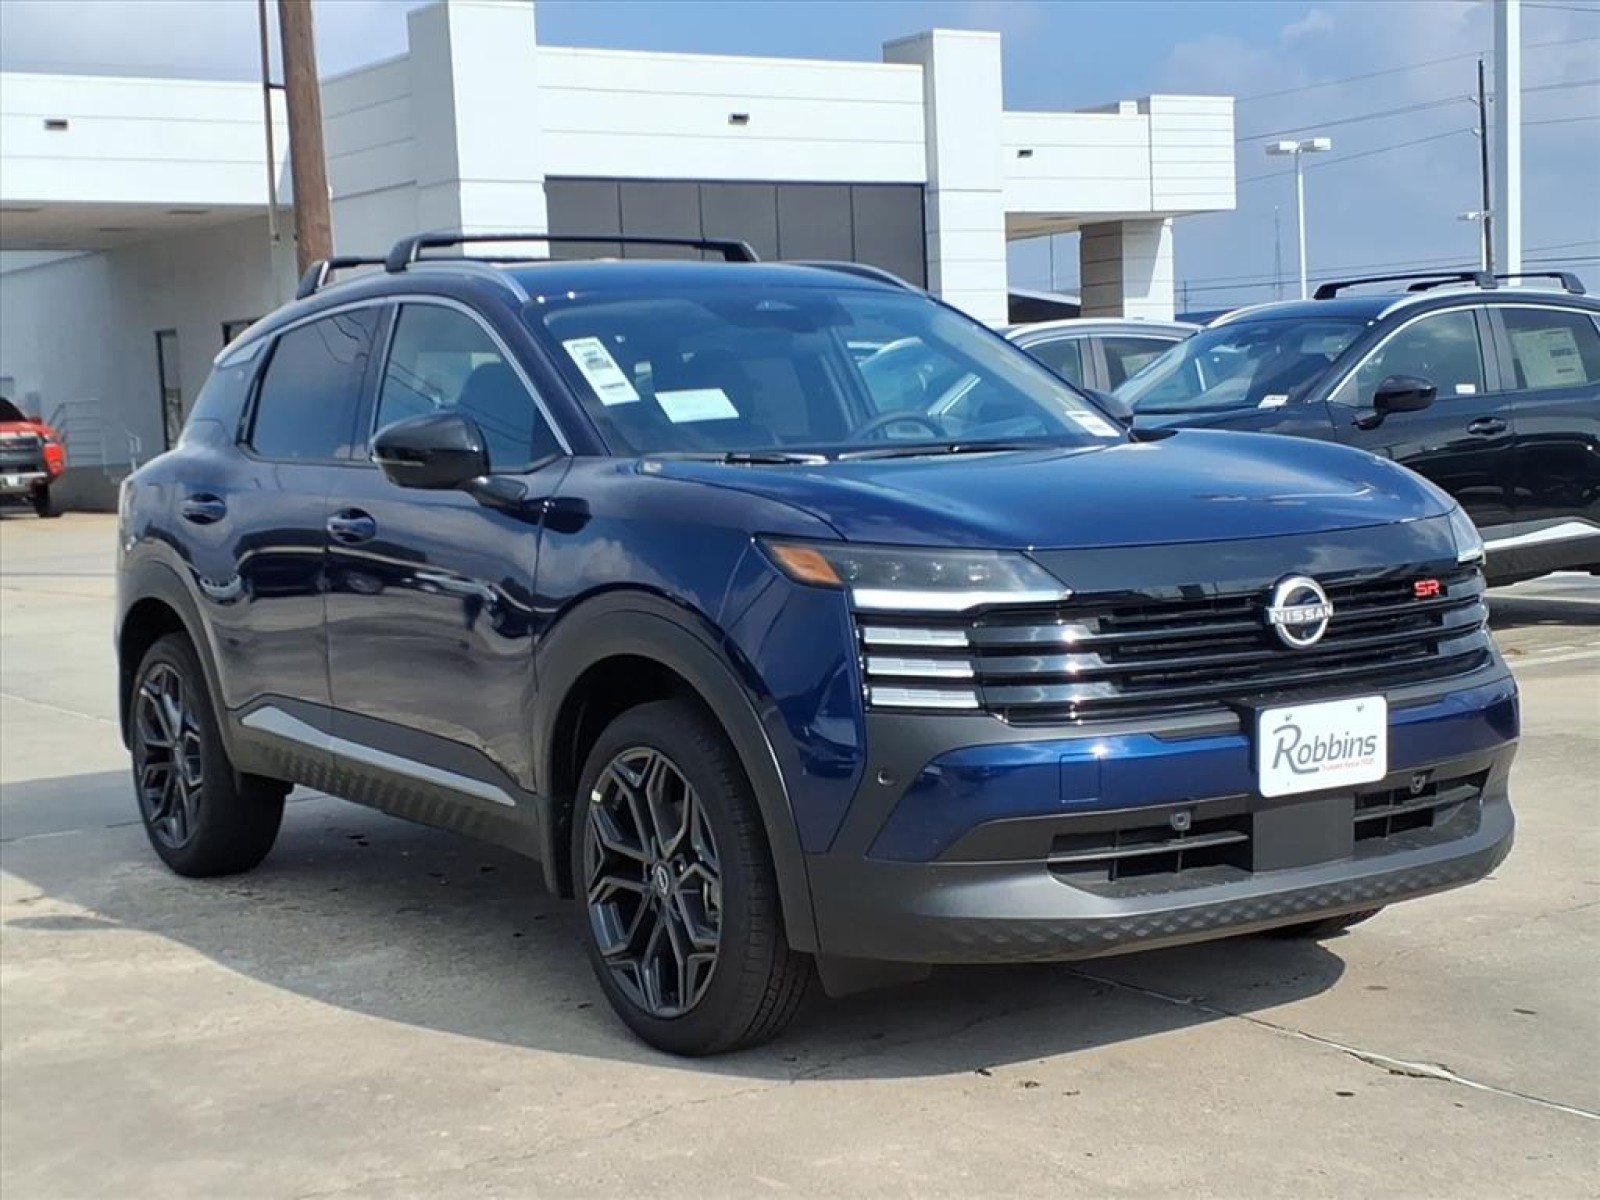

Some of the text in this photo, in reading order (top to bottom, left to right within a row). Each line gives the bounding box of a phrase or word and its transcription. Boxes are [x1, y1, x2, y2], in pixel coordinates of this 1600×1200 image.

[1414, 579, 1440, 597] SR
[1269, 602, 1333, 624] NISSAN
[1272, 724, 1378, 775] Robbins
